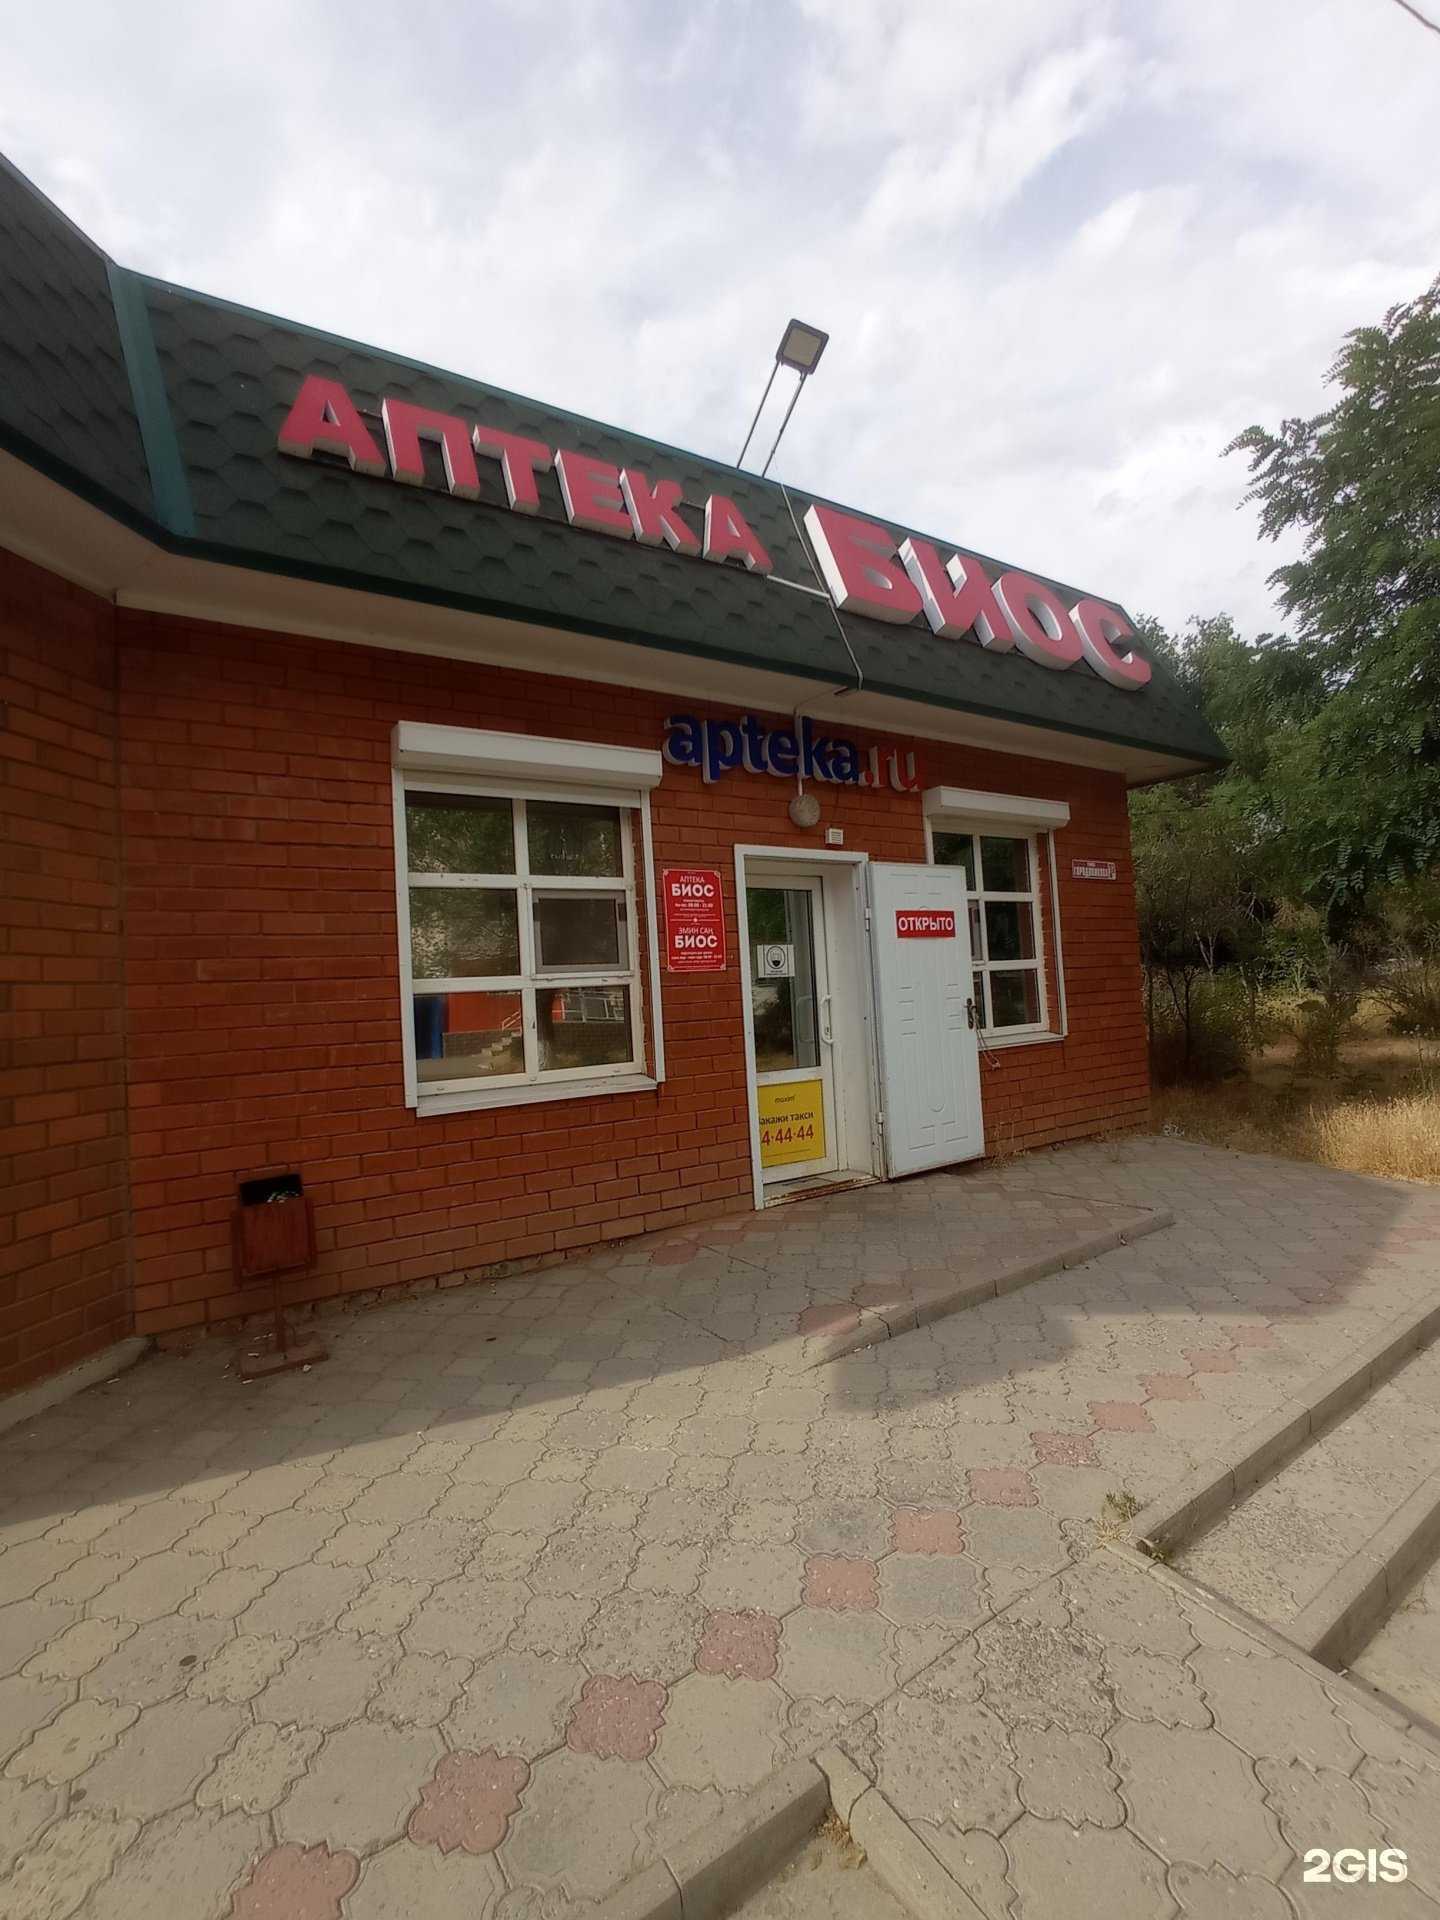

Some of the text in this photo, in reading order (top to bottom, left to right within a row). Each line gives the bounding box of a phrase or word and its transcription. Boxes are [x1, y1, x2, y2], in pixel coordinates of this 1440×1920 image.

[278, 374, 1152, 691] АПТЕКА БИОС
[662, 713, 928, 792] apteka.ru
[679, 875, 705, 884] АПТЕКА
[671, 883, 715, 897] БИОС
[898, 916, 954, 931] ОТКРЫТО
[674, 935, 718, 948] БИОС
[759, 1115, 788, 1125] акажи
